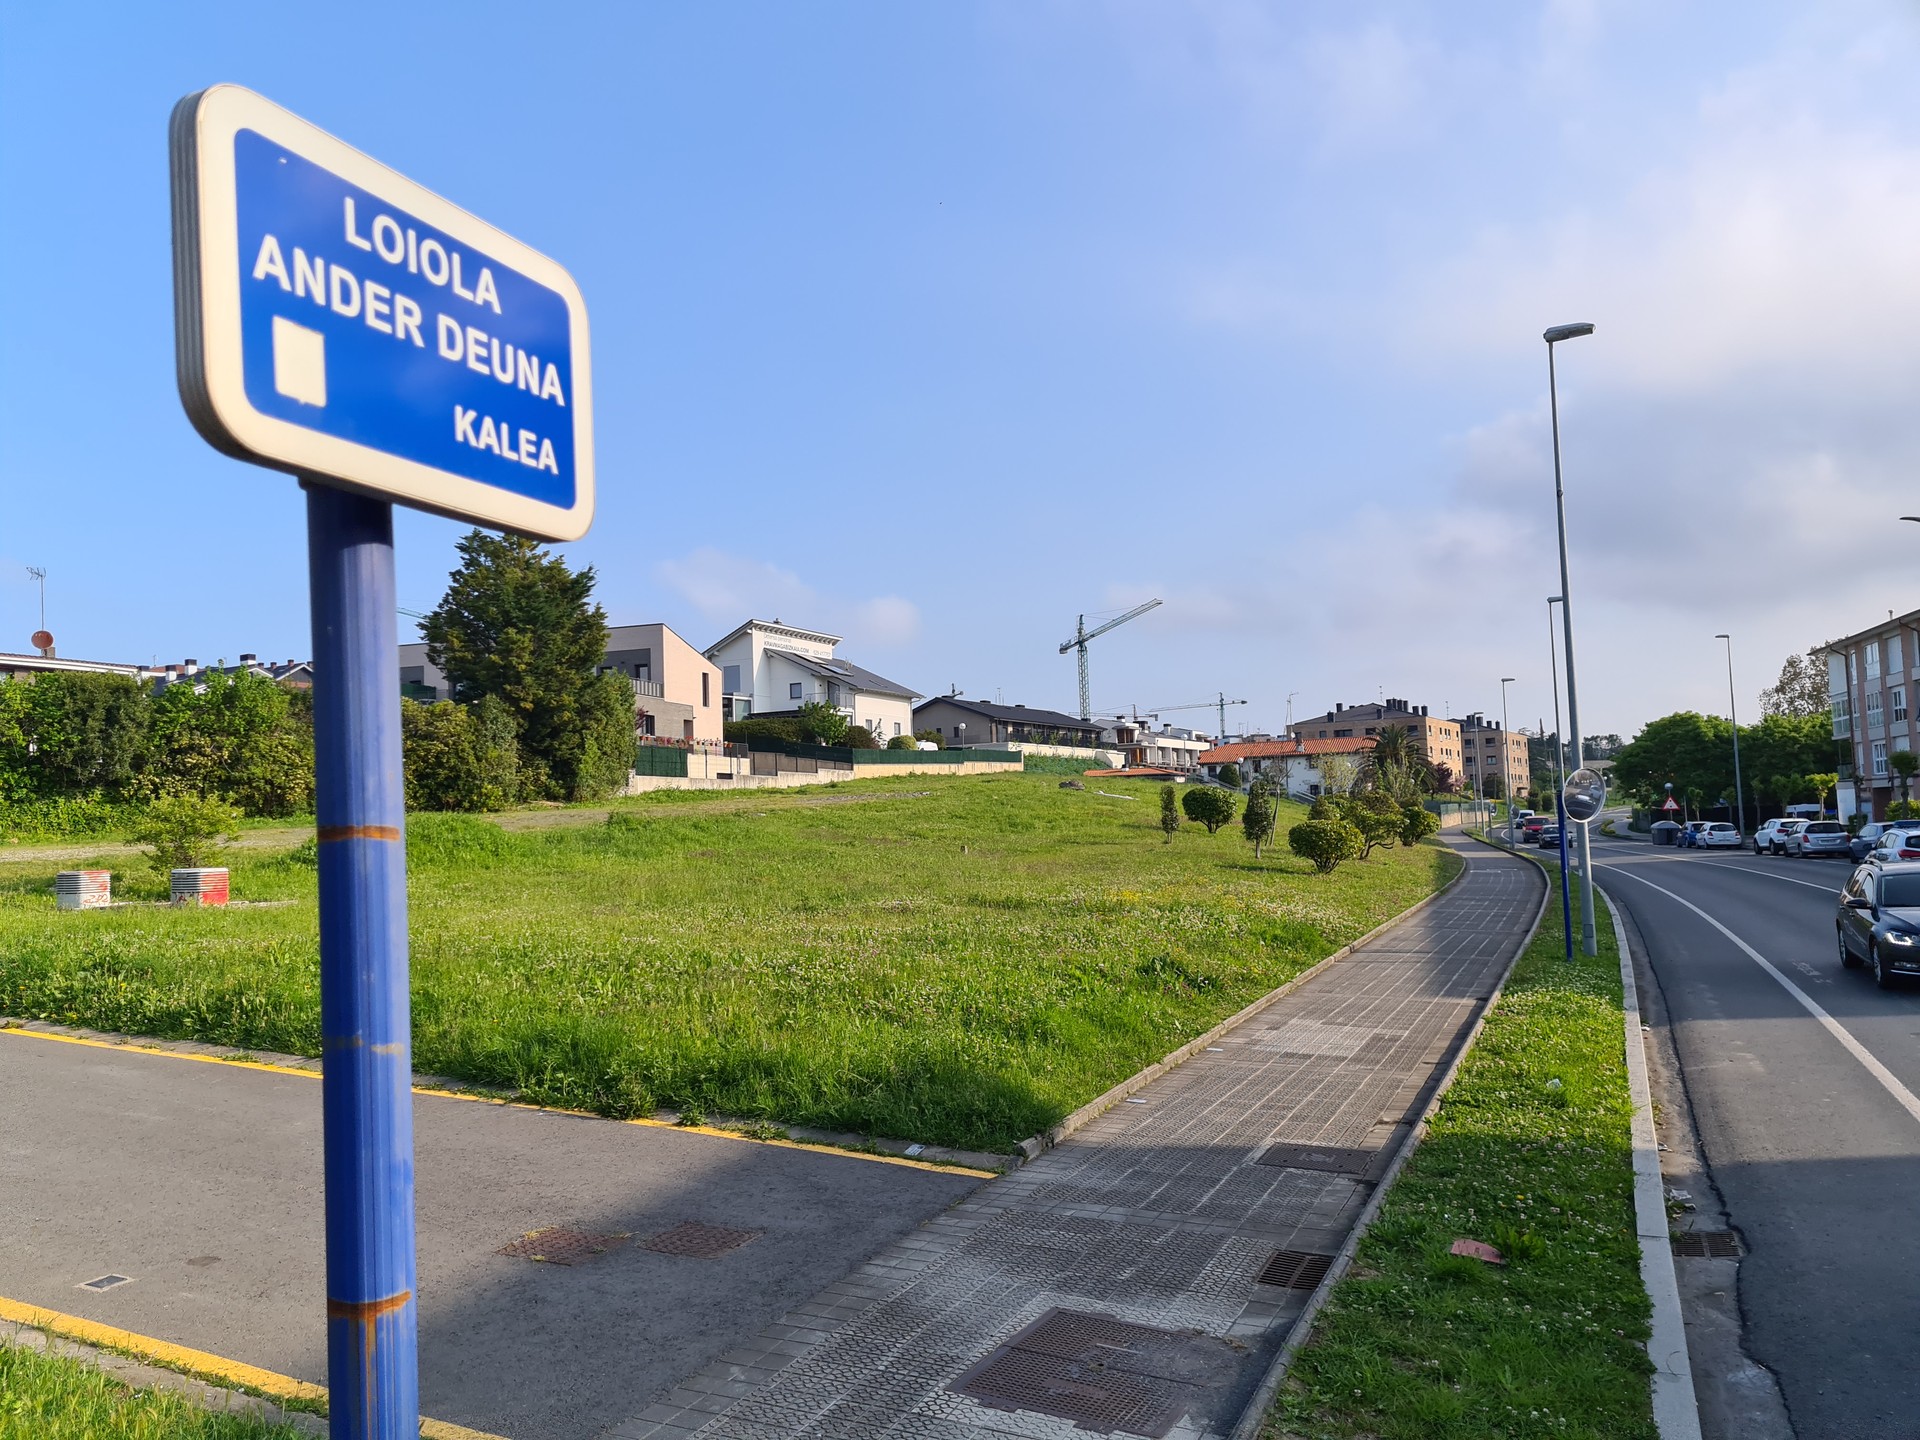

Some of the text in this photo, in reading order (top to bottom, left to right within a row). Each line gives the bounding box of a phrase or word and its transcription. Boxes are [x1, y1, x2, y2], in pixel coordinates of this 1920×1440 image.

[344, 196, 502, 315] LOIOLA
[252, 234, 565, 406] ANDER DEUNA
[454, 405, 559, 475] KALEA
